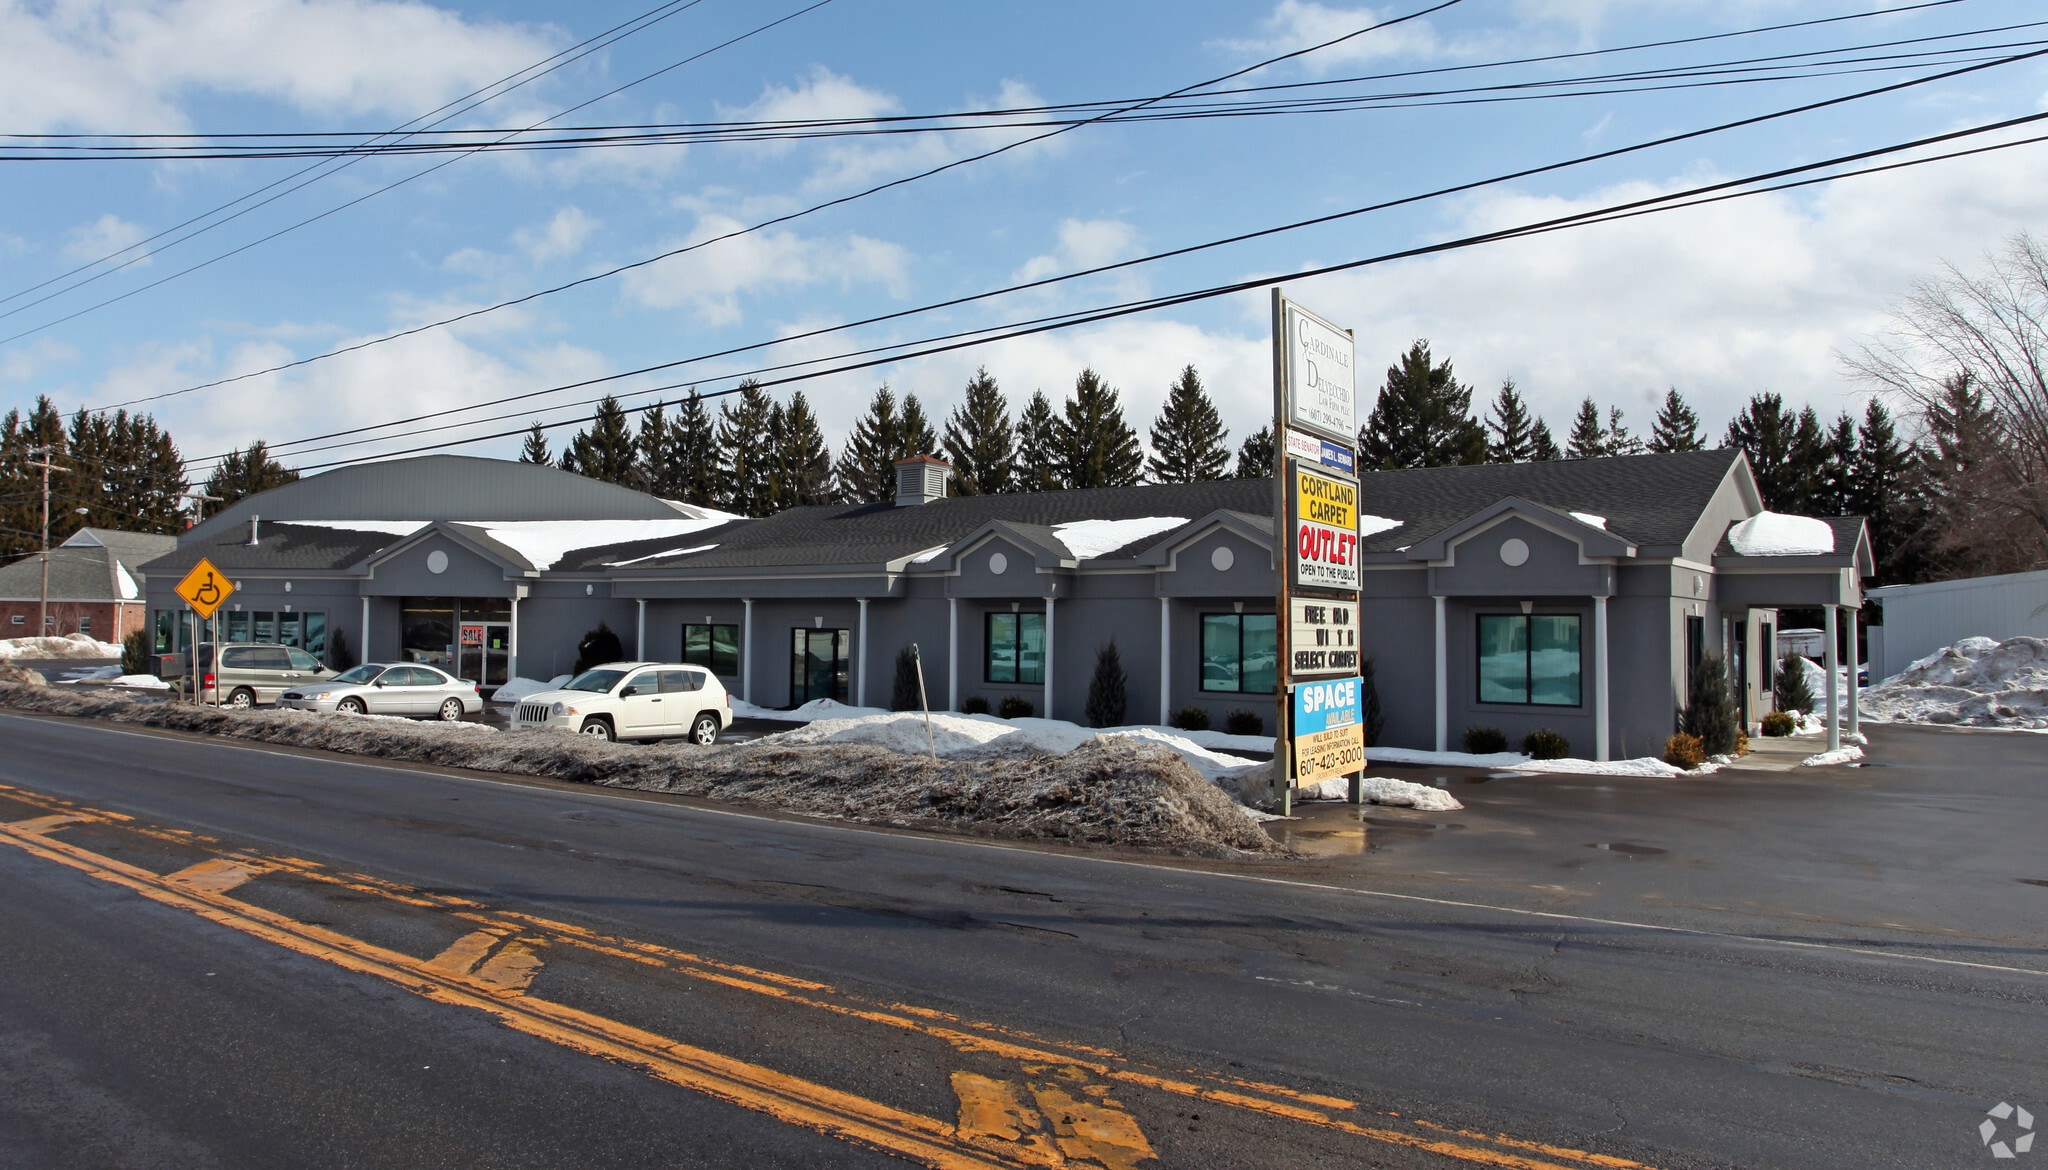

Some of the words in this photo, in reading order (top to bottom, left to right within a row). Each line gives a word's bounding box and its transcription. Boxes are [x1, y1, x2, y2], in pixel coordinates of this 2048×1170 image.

[1288, 435, 1301, 449] STATE
[1301, 440, 1319, 455] SENATOR
[1302, 475, 1353, 505] CORTLAND
[1310, 499, 1348, 525] CARPET
[1298, 524, 1356, 566] OUTLET
[1300, 563, 1316, 576] OPEN
[1317, 565, 1325, 577] TO
[1326, 567, 1336, 579] THE
[1338, 569, 1355, 581] PUBLIC
[1305, 605, 1326, 624] FREE
[463, 629, 482, 642] SALE
[1294, 650, 1327, 670] SELECT
[1328, 650, 1358, 669] CARPET
[1303, 681, 1355, 714] SPACE
[1327, 708, 1355, 725] AVAILABLE
[1313, 733, 1323, 742] WILL
[1333, 729, 1339, 739] TO
[1310, 743, 1326, 755] LEASING
[1300, 746, 1362, 777] 607-423-3000
